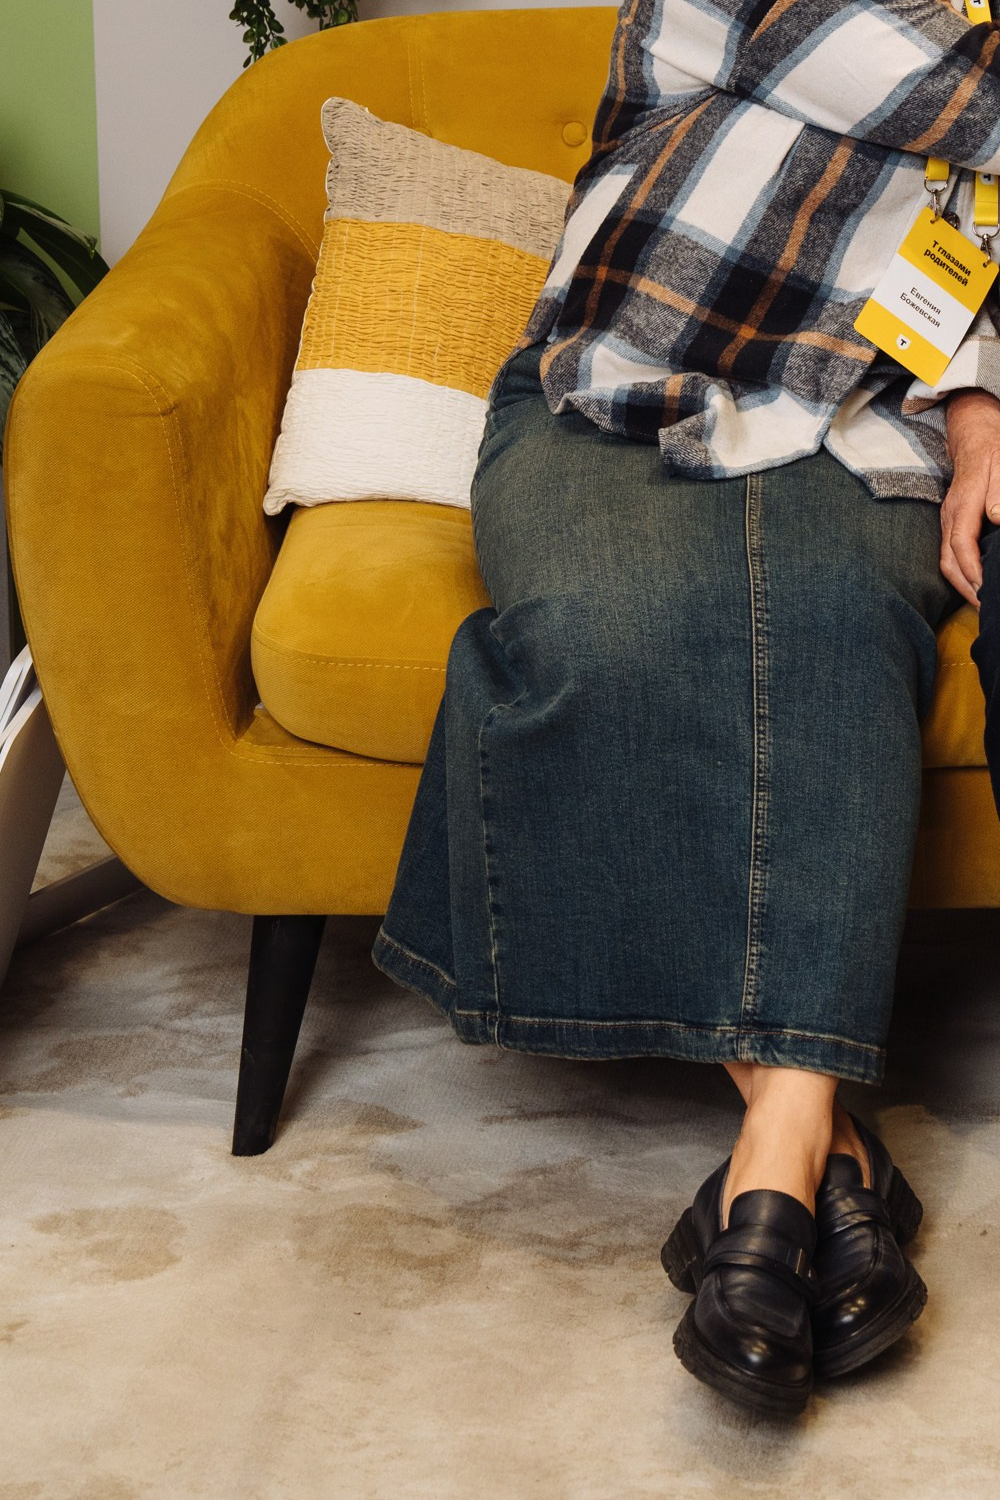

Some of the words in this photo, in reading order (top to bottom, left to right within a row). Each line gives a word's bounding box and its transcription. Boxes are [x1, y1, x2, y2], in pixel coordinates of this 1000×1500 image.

[923, 248, 969, 287] родителей
[932, 239, 939, 248] Т
[937, 246, 972, 277] глазами
[900, 292, 941, 328] Божевская
[910, 286, 942, 315] Евгения
